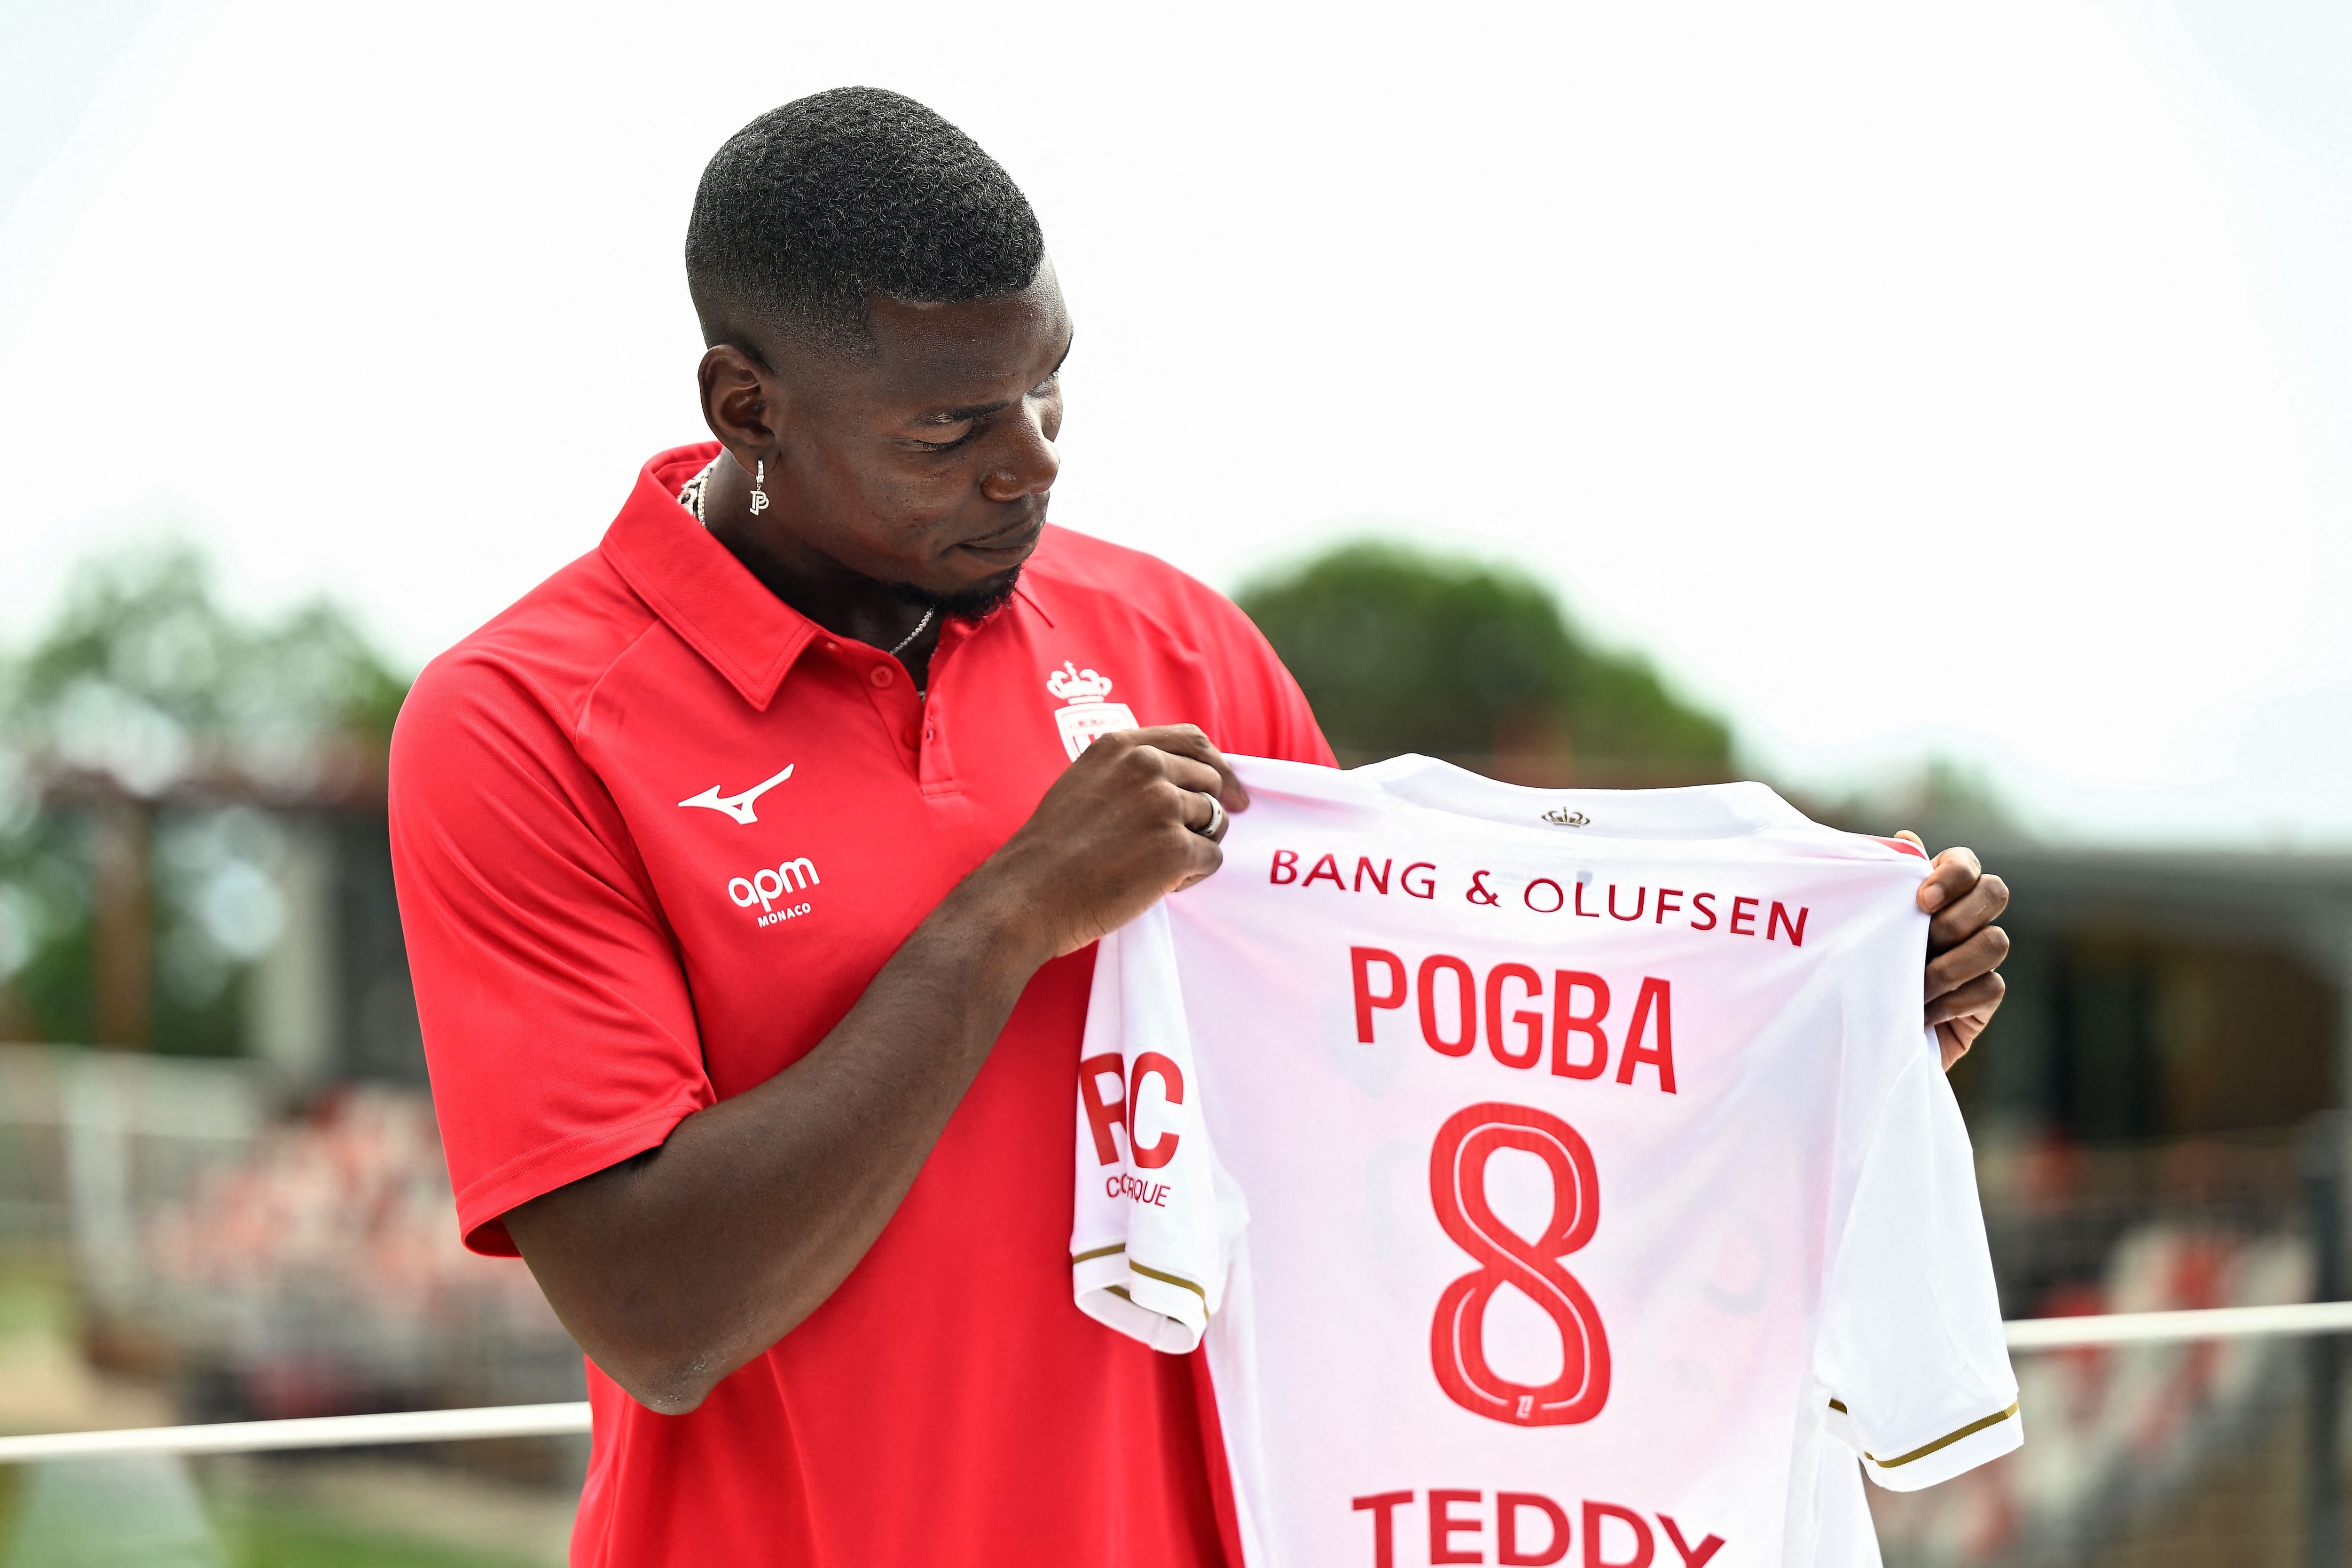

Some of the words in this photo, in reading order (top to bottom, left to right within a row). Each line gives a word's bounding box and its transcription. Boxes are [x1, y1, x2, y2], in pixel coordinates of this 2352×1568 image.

[728, 857, 821, 913] apm
[757, 902, 811, 928] MONACO
[1270, 849, 1437, 900] BANG
[1466, 870, 1501, 907] &
[1523, 878, 1810, 948] OLUFSEN
[1349, 945, 1678, 1095] POGBA
[1428, 1100, 1612, 1428] 8
[1351, 1489, 1726, 1568] TEDDY
